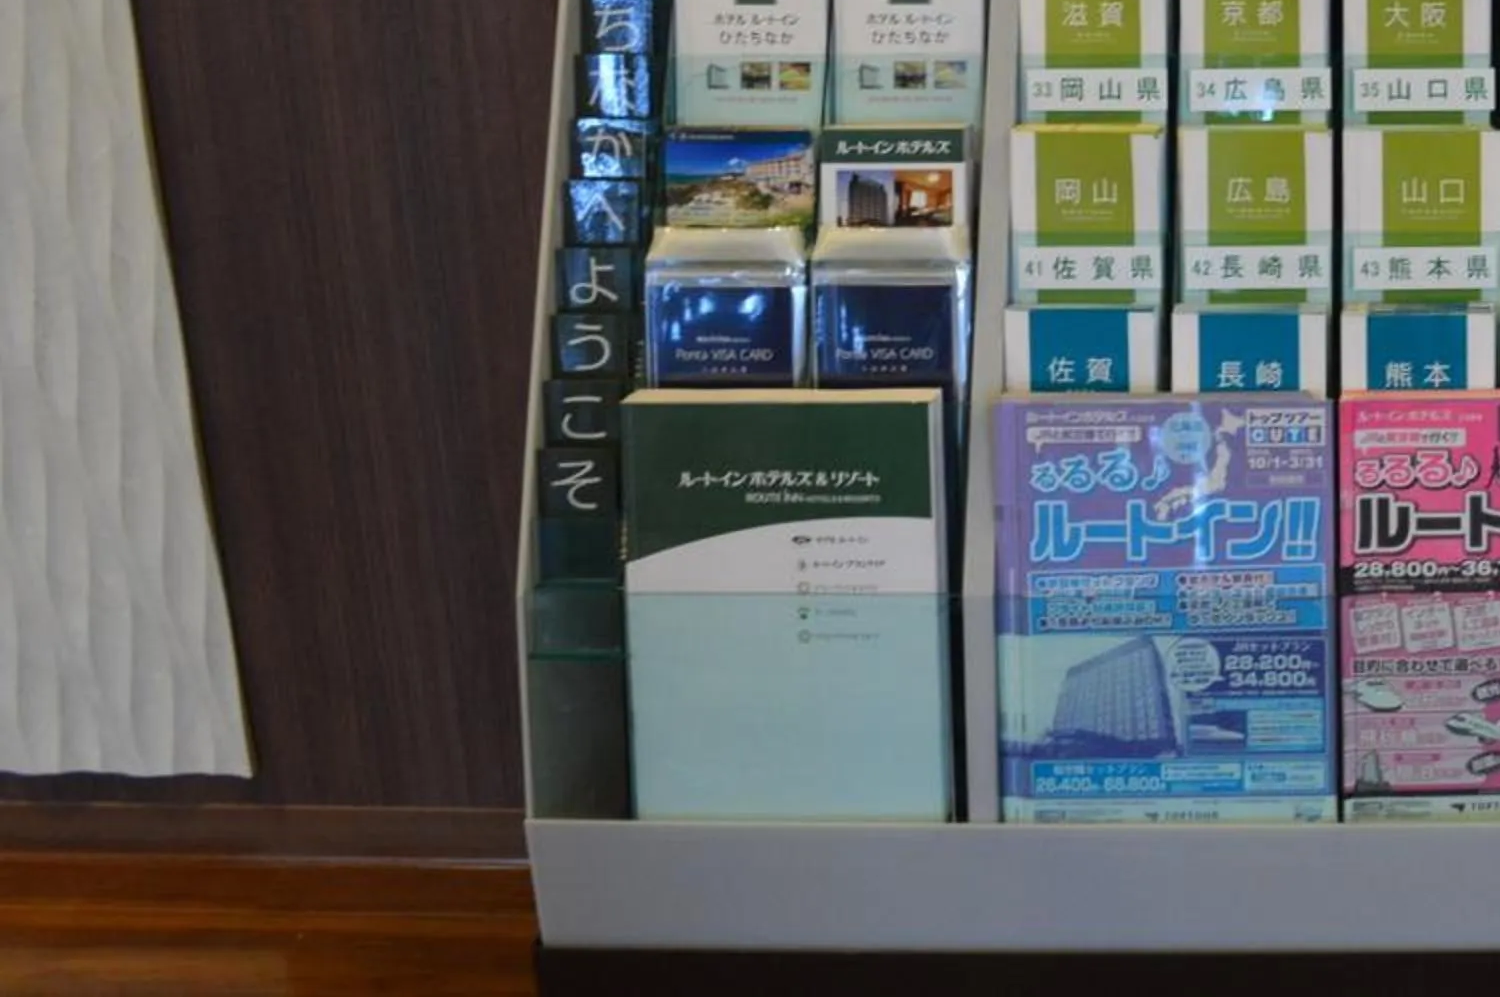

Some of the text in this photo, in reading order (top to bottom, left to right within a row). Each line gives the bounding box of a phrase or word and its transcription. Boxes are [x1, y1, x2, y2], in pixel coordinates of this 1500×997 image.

[1062, 0, 1124, 28] 滋賀
[1221, 0, 1283, 26] 京都
[1383, 1, 1446, 28] 大阪
[720, 30, 794, 45] ひたちなか
[871, 30, 949, 45] ひたちなか
[1061, 76, 1161, 101] 岡山県
[1225, 75, 1324, 100] 広島県
[1388, 76, 1487, 100] 山口県
[836, 140, 951, 154] ルートイン ホテルズ
[1055, 177, 1118, 205] 岡山
[1227, 177, 1291, 204] 広島
[1402, 176, 1465, 204] 山口
[1025, 255, 1153, 281] 41 佐賀県
[1221, 254, 1321, 280] 長崎県
[1360, 255, 1489, 280] 43 熊本県
[711, 349, 736, 360] VISA
[740, 348, 774, 361] CARD
[871, 348, 898, 360] VISA
[901, 348, 934, 360] CARD
[1047, 356, 1113, 383] 佐賀
[1217, 361, 1283, 389] 長崎
[1385, 362, 1451, 388] 熊本
